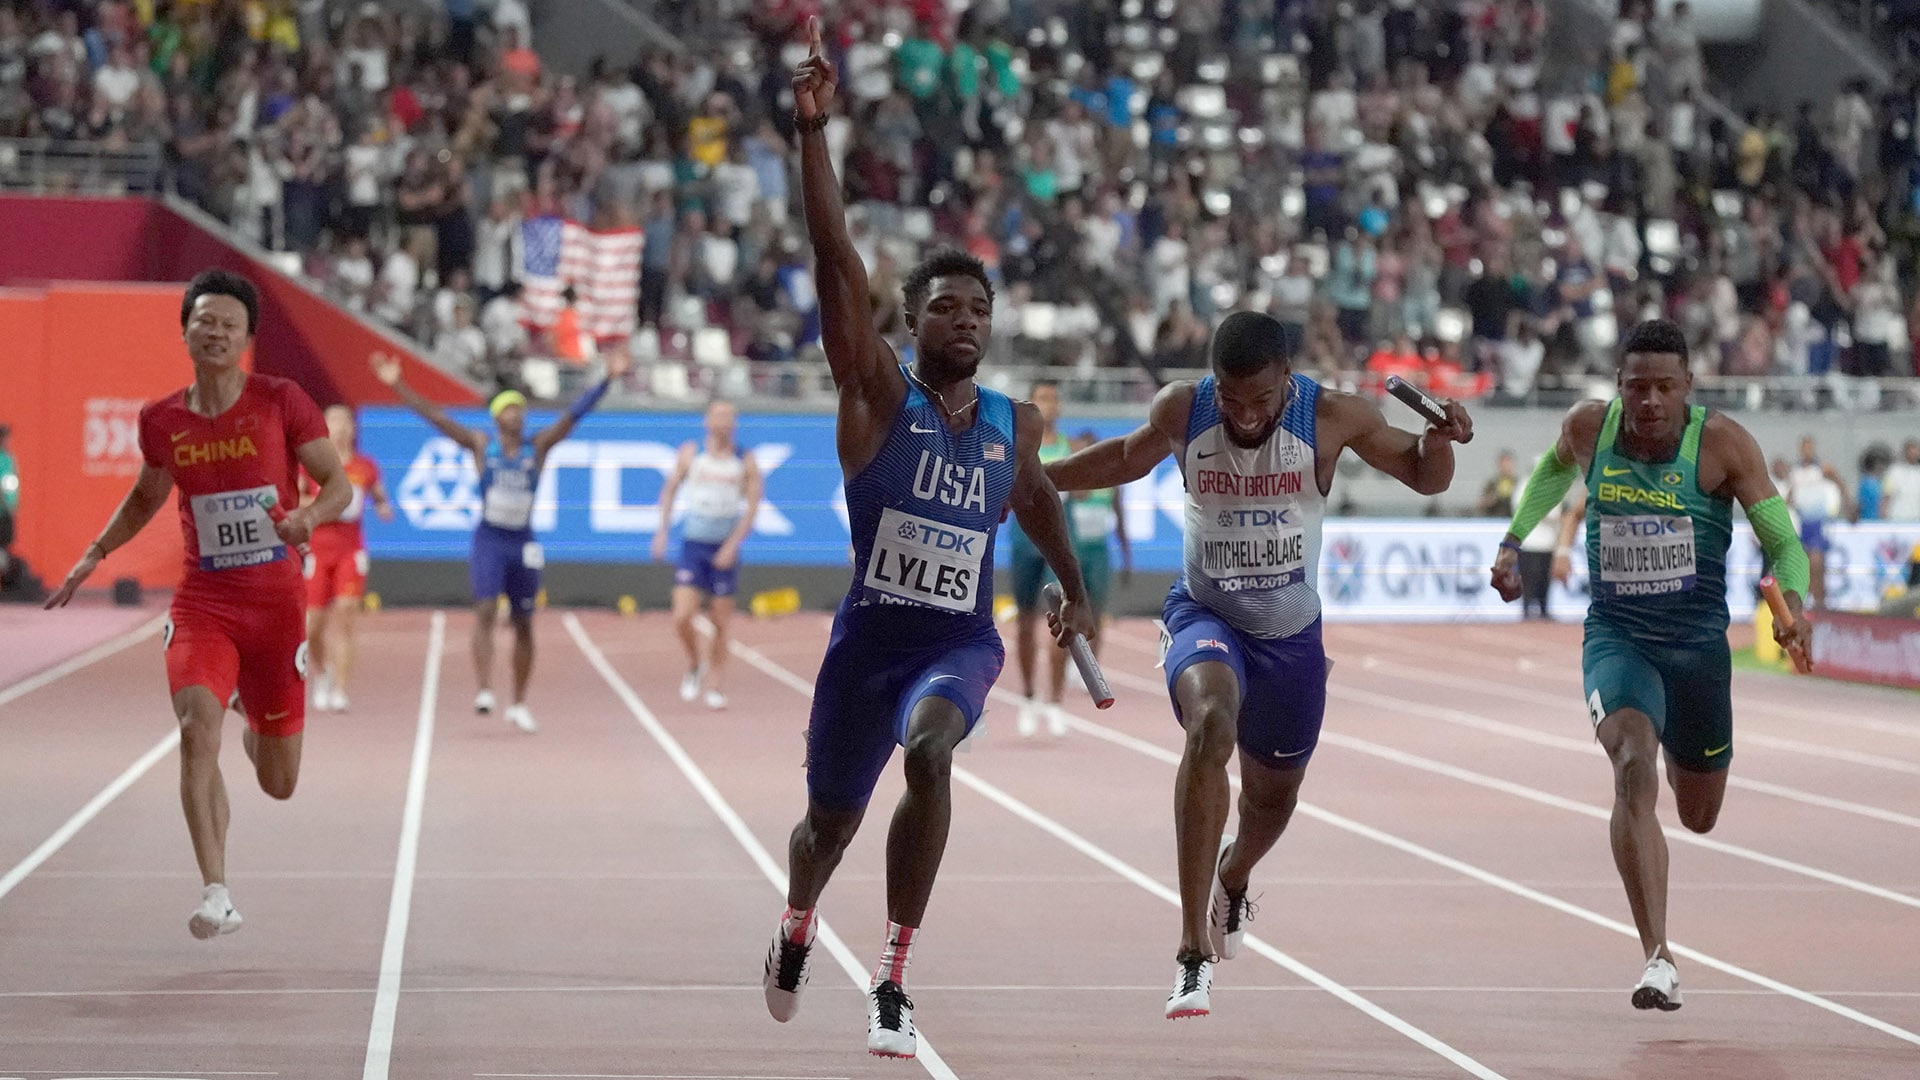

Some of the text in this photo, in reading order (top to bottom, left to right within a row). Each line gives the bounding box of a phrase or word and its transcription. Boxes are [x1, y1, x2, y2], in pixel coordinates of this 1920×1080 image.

[174, 435, 258, 467] CHINA
[912, 449, 986, 513] USA
[1197, 470, 1302, 497] GREAT BRITAIN
[217, 492, 266, 512] TDK
[1599, 483, 1685, 510] BRASIL
[1233, 509, 1290, 527] TDK
[1627, 519, 1678, 536] TDK
[218, 519, 260, 547] BIE
[919, 524, 976, 556] TDK
[1204, 534, 1303, 570] MITCHELL-BLAKE
[1602, 542, 1693, 573] CAMILO DE OLIVEIRA
[874, 548, 971, 601] LYLES
[1219, 573, 1291, 592] DOHA2019
[1616, 578, 1683, 596] DOHA2019
